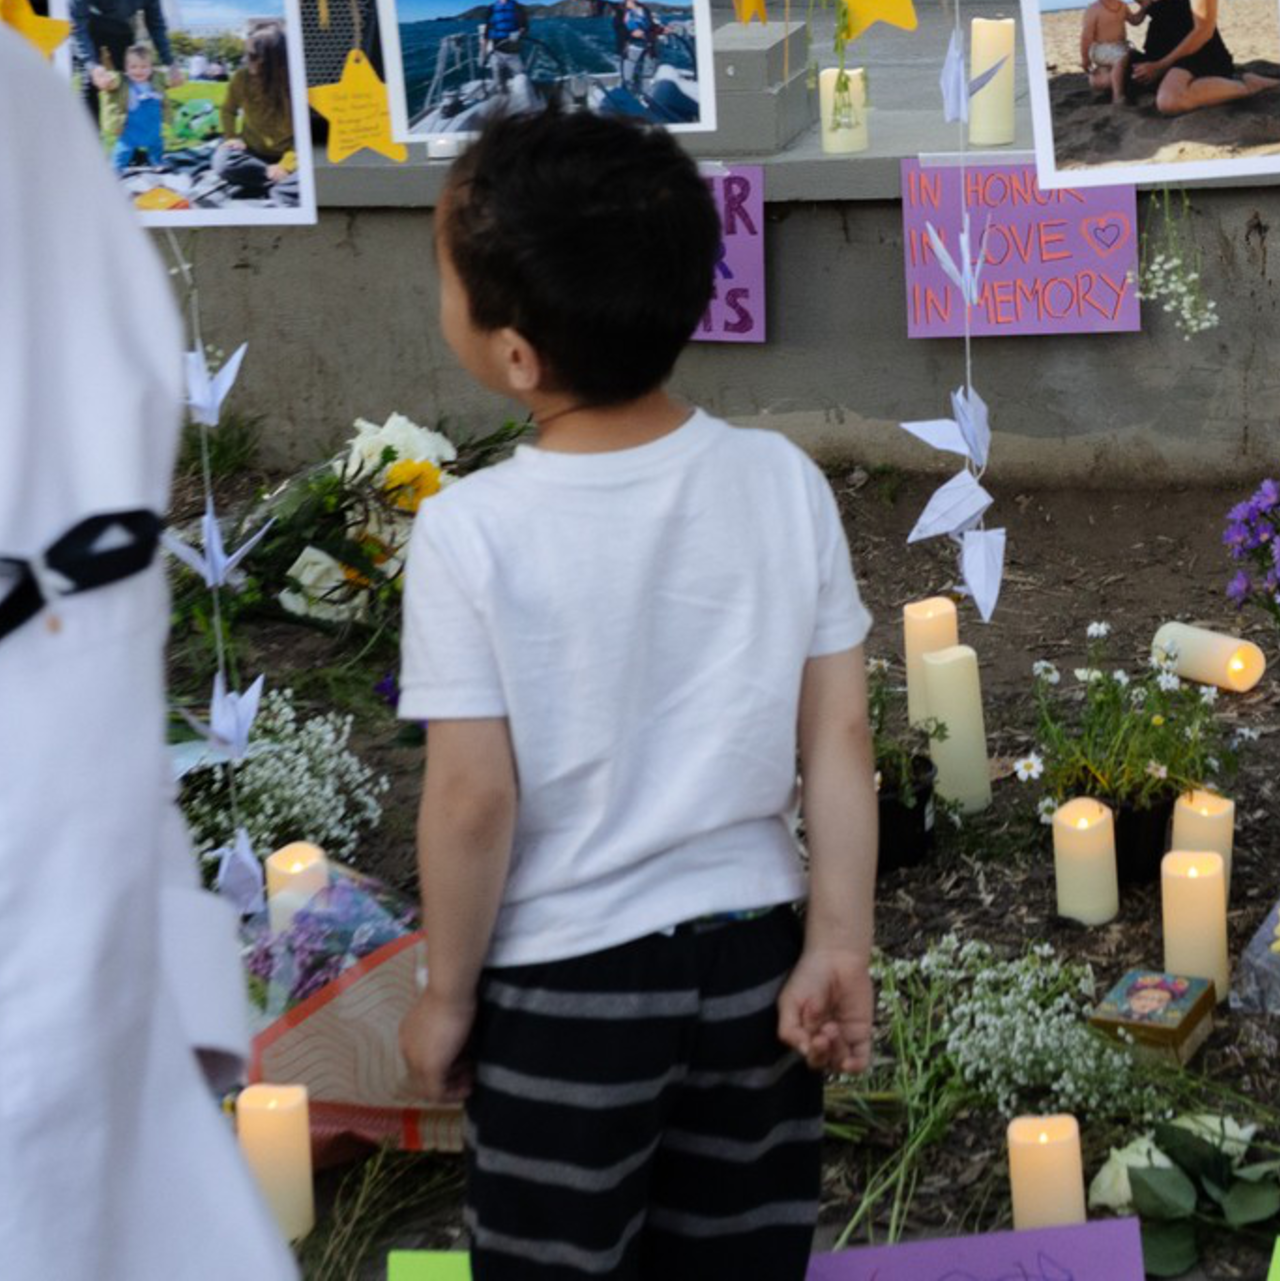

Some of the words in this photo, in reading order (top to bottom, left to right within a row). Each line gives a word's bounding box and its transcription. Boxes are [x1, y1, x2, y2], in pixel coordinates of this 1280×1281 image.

[908, 170, 941, 210] IN
[913, 283, 952, 325] IN
[968, 270, 1129, 326] MEMORY
